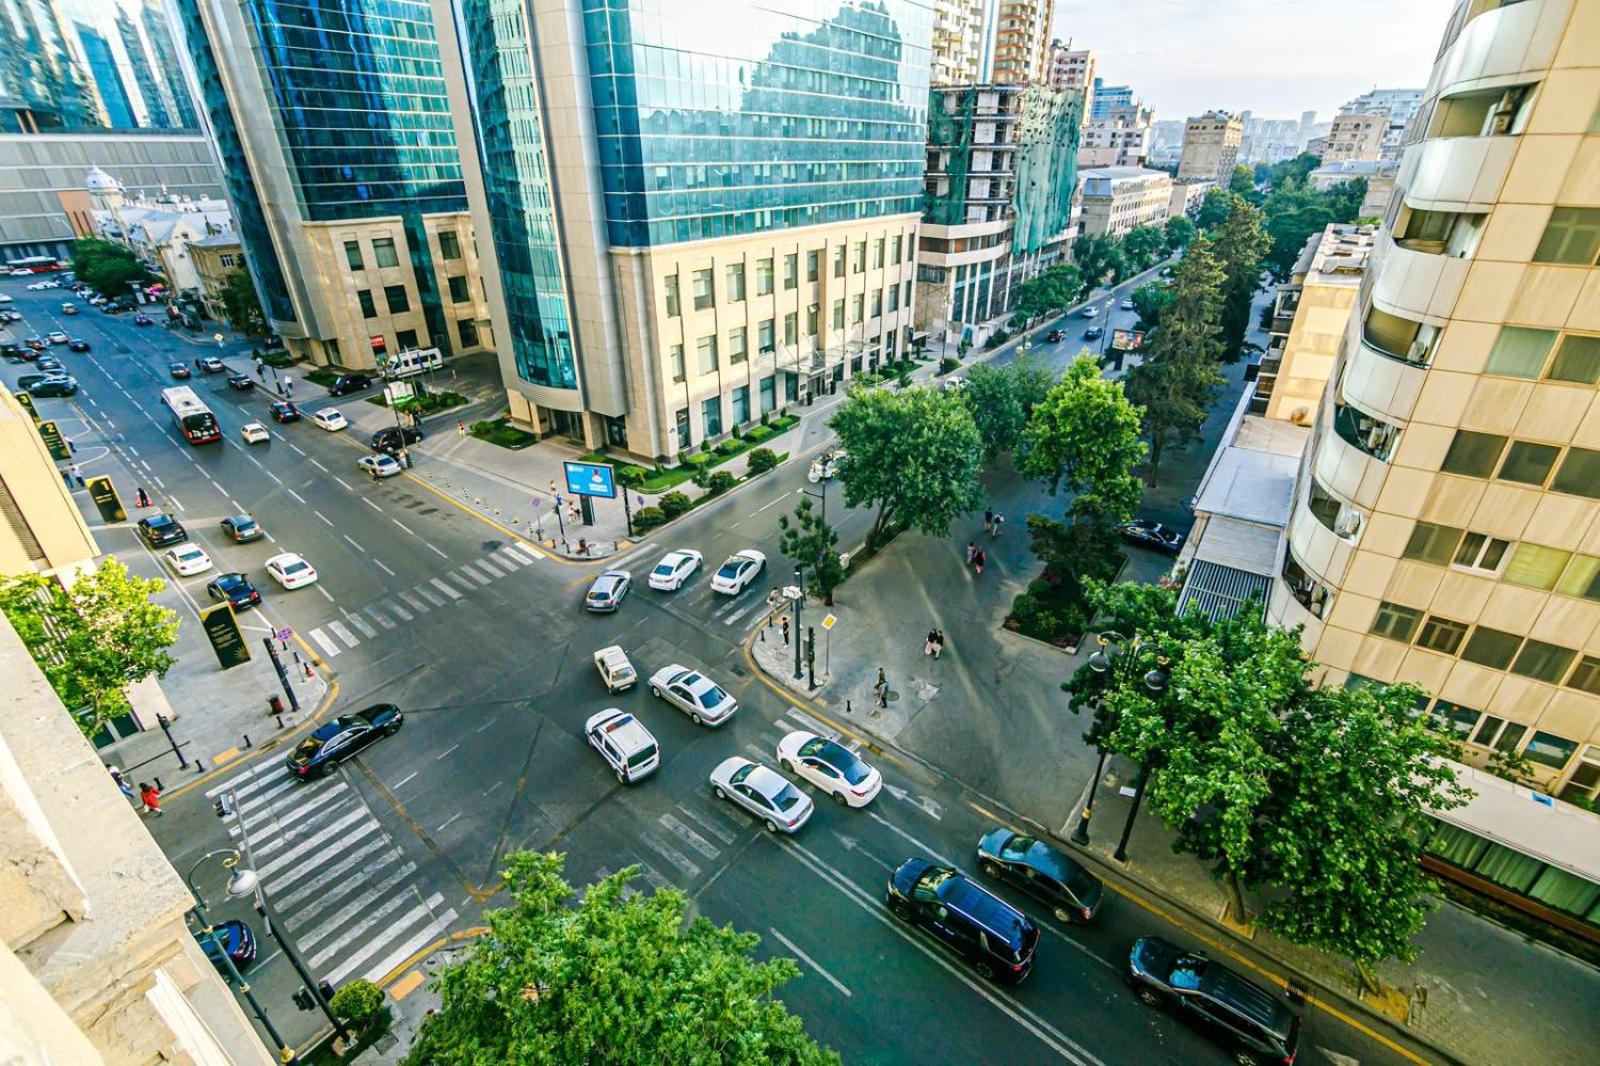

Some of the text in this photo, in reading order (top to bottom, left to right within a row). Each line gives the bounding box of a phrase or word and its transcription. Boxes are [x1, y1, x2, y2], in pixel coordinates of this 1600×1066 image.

[19, 395, 29, 404] 3
[46, 423, 56, 433] 2
[100, 480, 110, 490] 1
